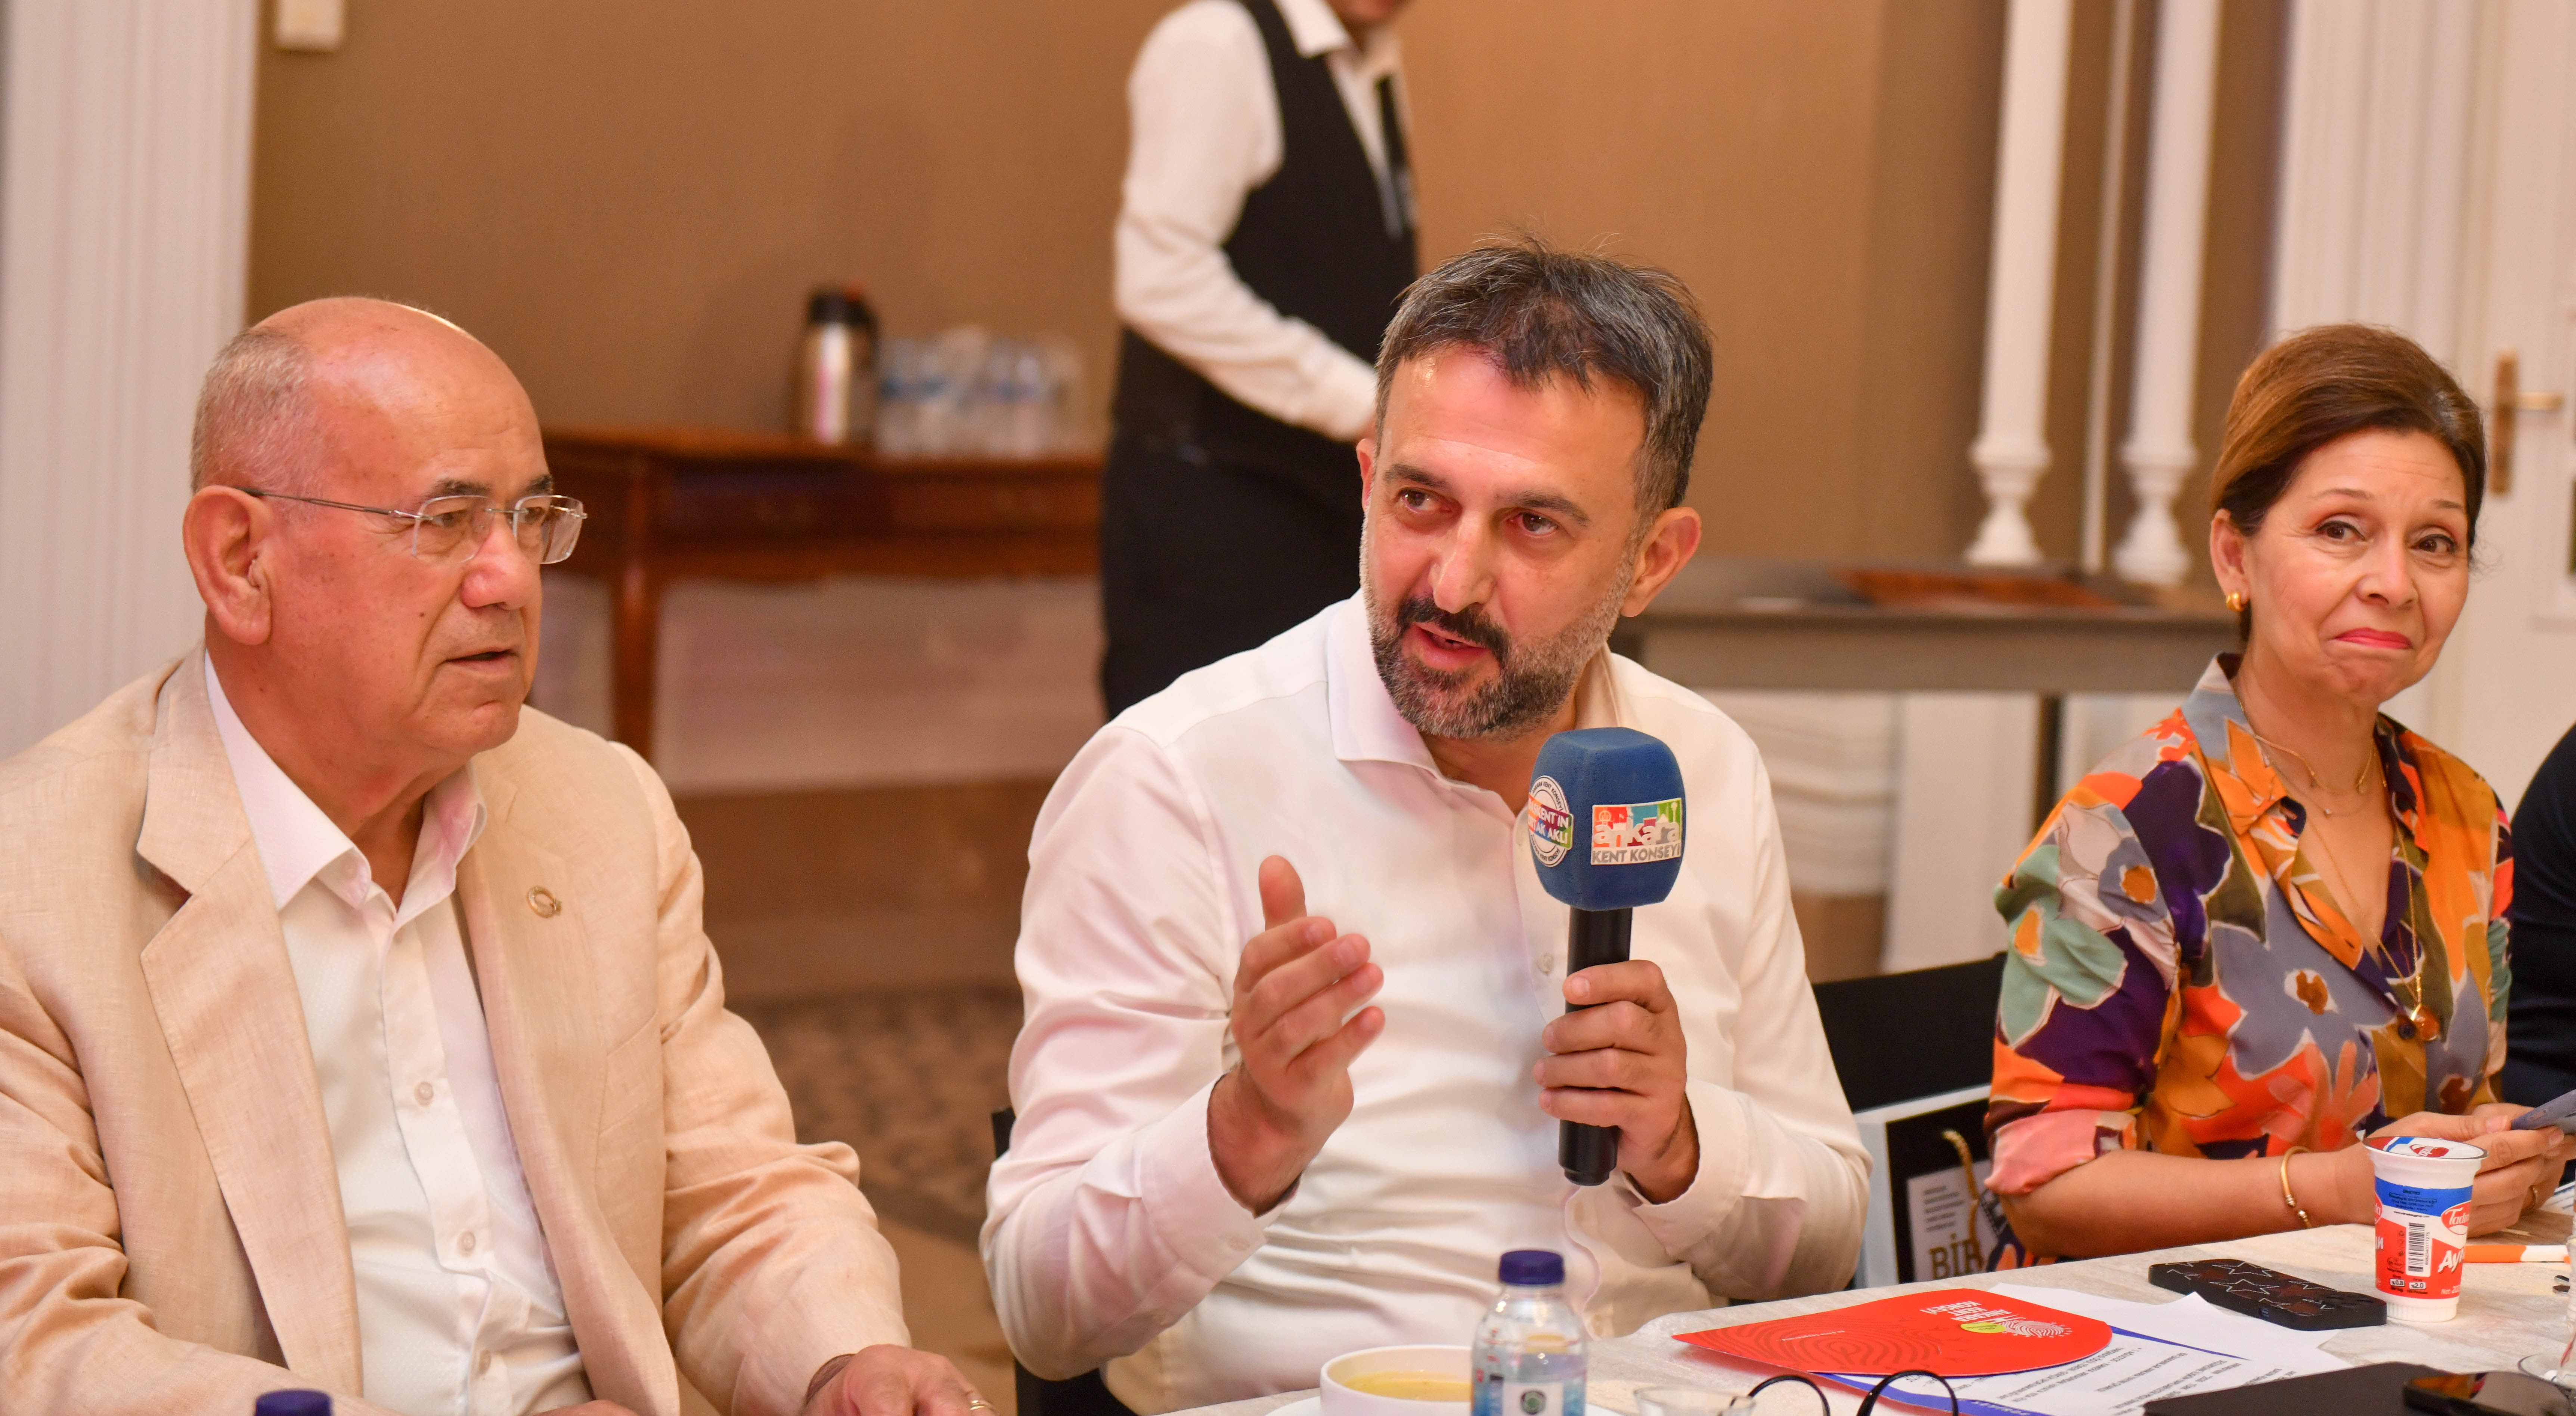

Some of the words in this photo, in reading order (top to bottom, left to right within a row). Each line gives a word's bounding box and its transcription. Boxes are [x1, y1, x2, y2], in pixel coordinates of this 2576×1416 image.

[1592, 850, 1627, 863] KENT
[1630, 843, 1680, 862] KONSEYİ
[1919, 1301, 1982, 1314] KONSEYİ
[1948, 1307, 1987, 1316] KENT
[1951, 1309, 2012, 1321] ANKARA
